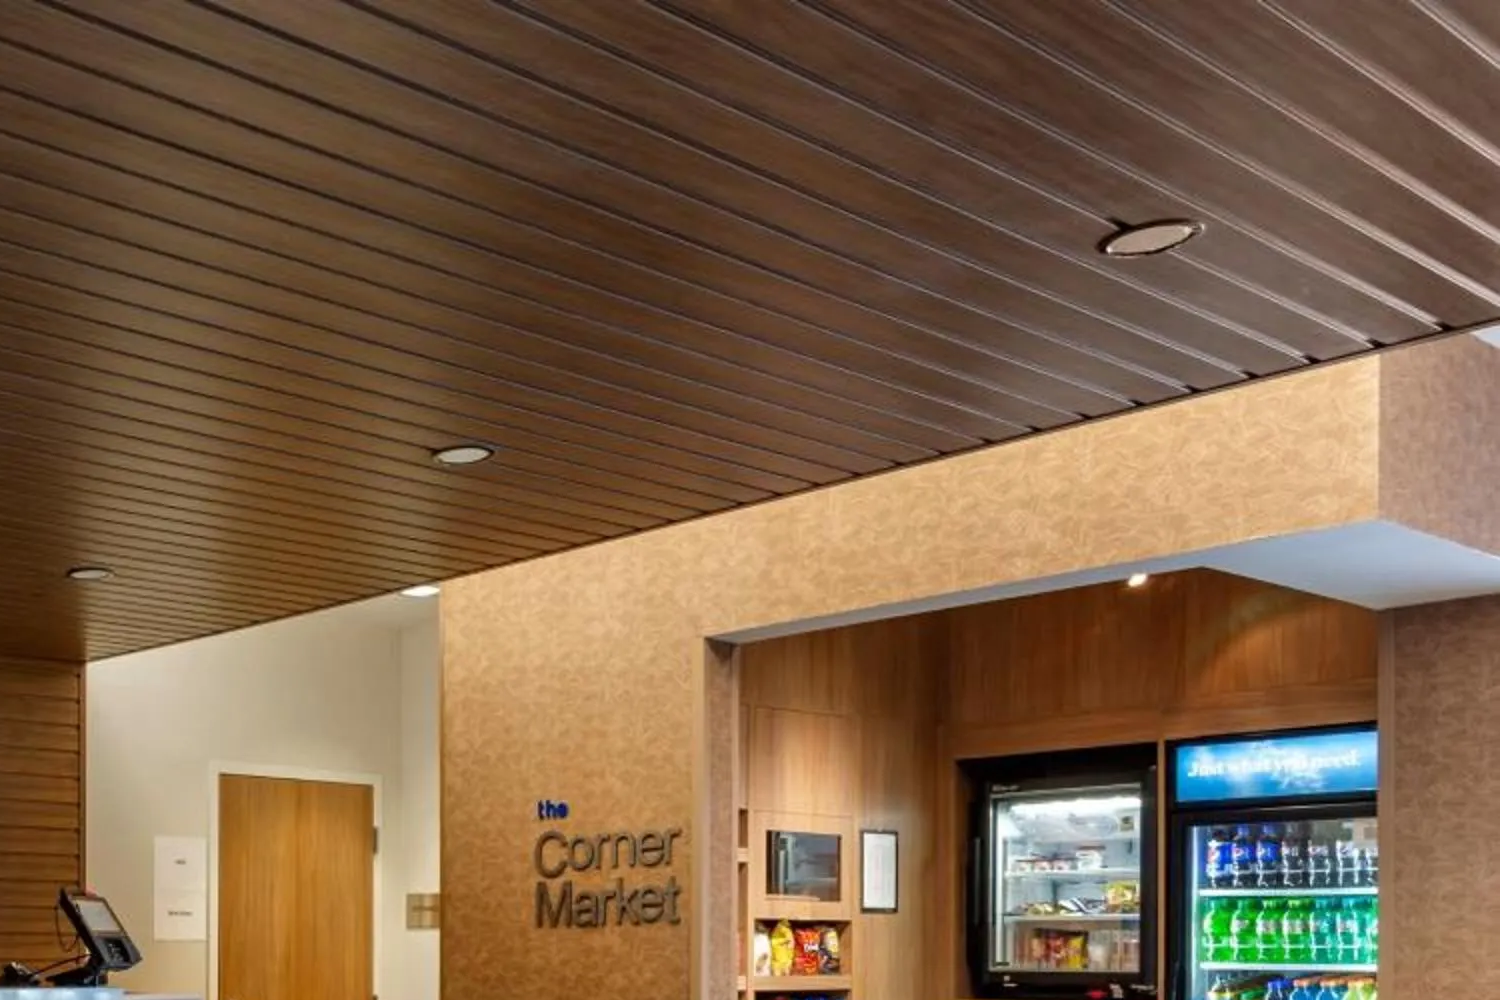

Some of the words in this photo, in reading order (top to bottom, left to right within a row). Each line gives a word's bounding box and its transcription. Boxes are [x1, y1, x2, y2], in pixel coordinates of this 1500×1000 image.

[536, 799, 569, 821] the
[534, 828, 683, 880] Corner
[534, 875, 683, 929] Market
